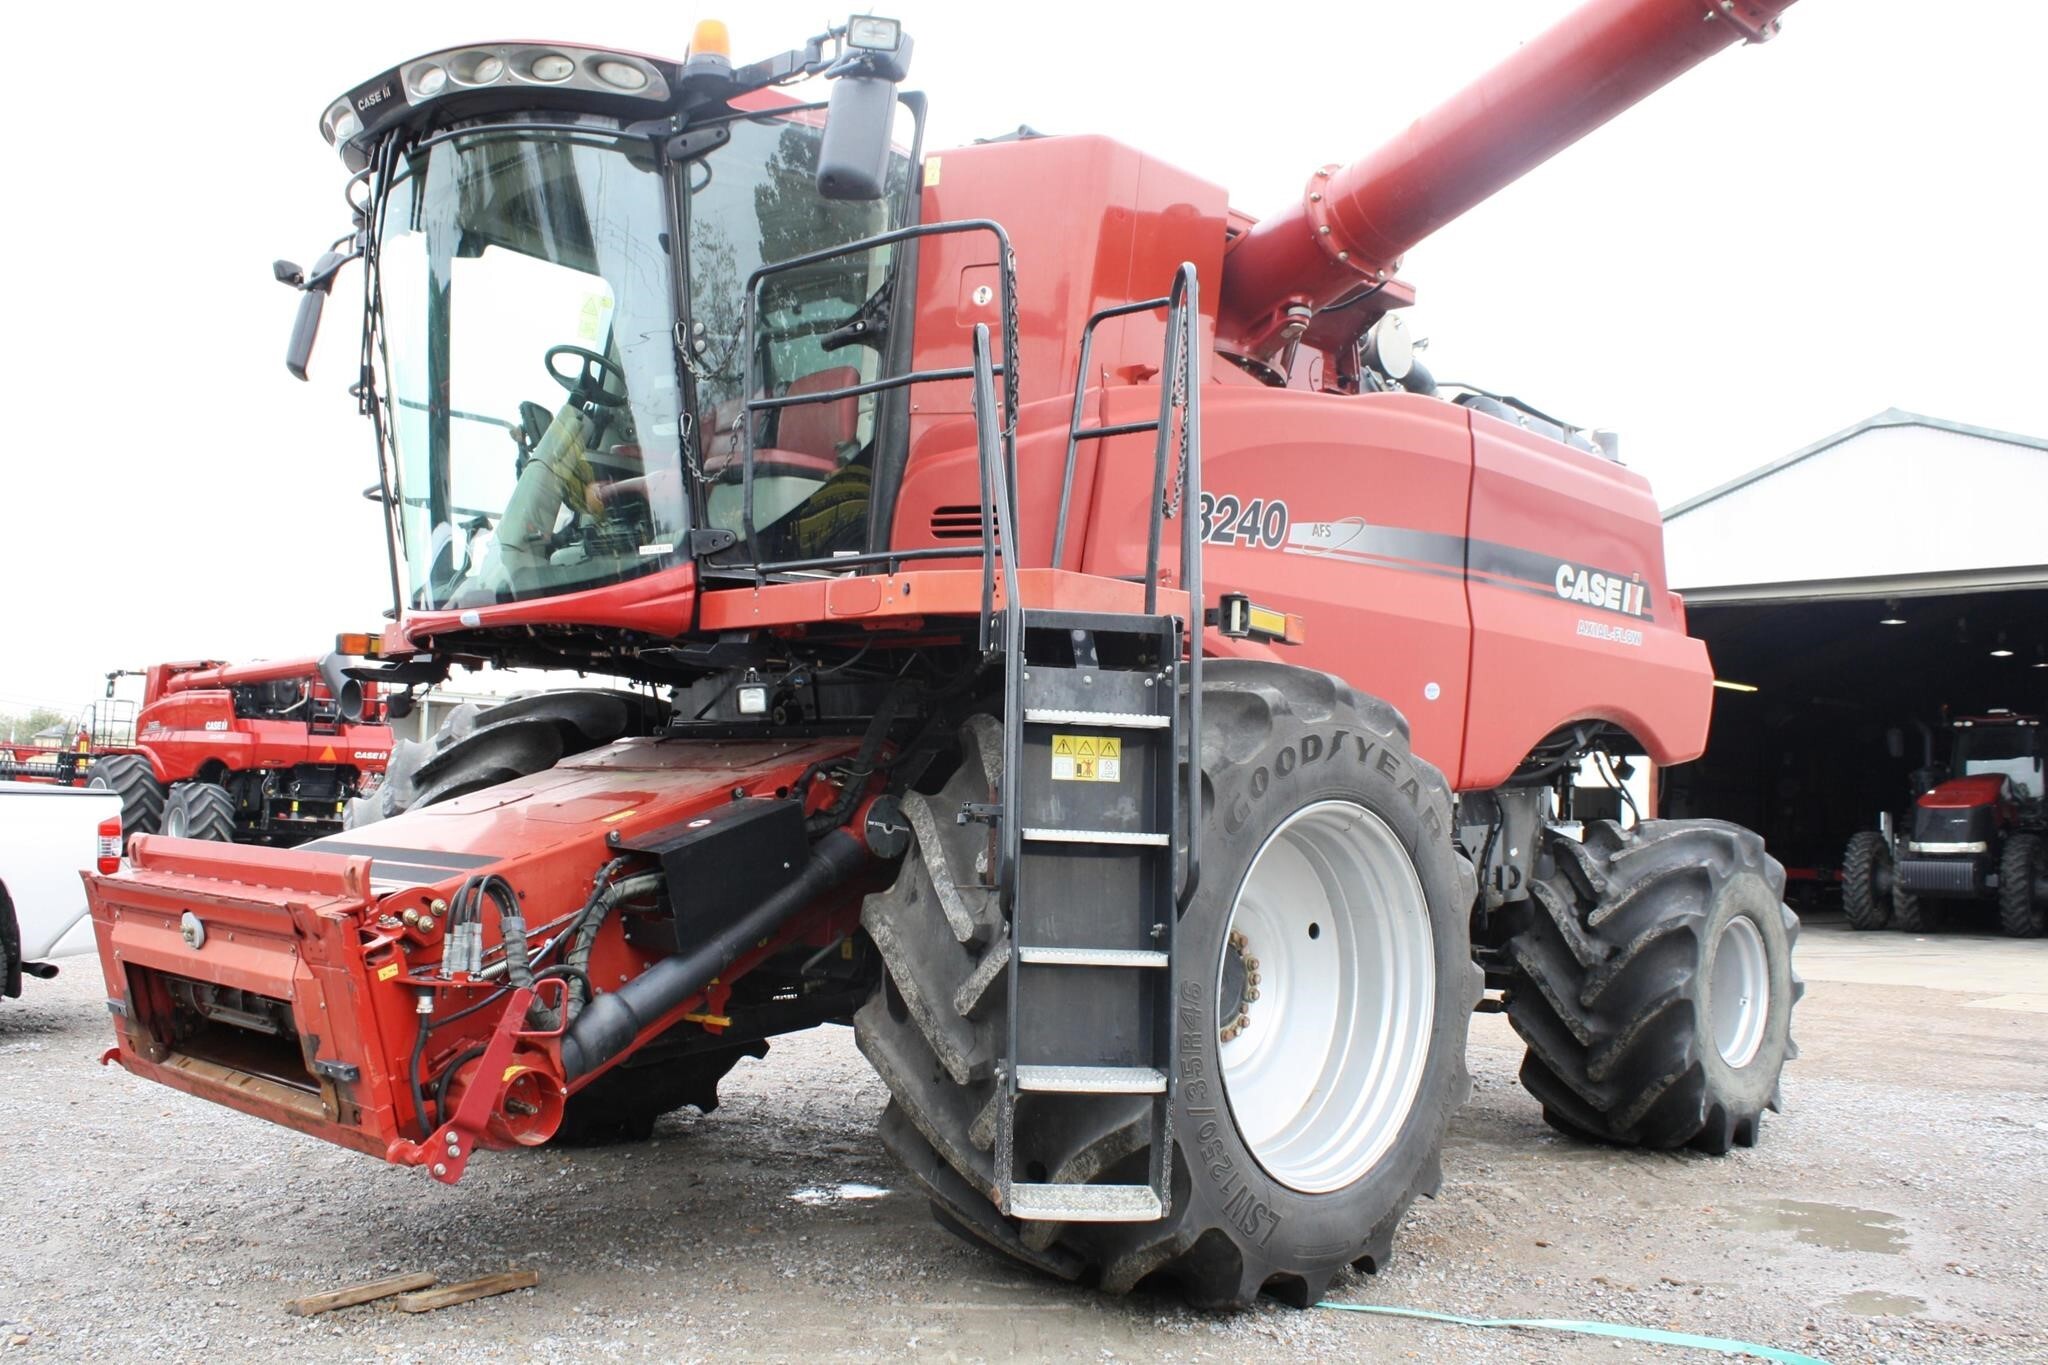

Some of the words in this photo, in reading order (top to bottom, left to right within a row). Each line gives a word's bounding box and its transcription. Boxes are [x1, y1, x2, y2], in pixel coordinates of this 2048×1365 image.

[358, 91, 382, 111] CASE
[1312, 524, 1332, 538] AFS
[1555, 564, 1622, 611] CASE
[1576, 620, 1642, 646] AXIAL-FLOW
[1222, 730, 1442, 846] GOODYEAR
